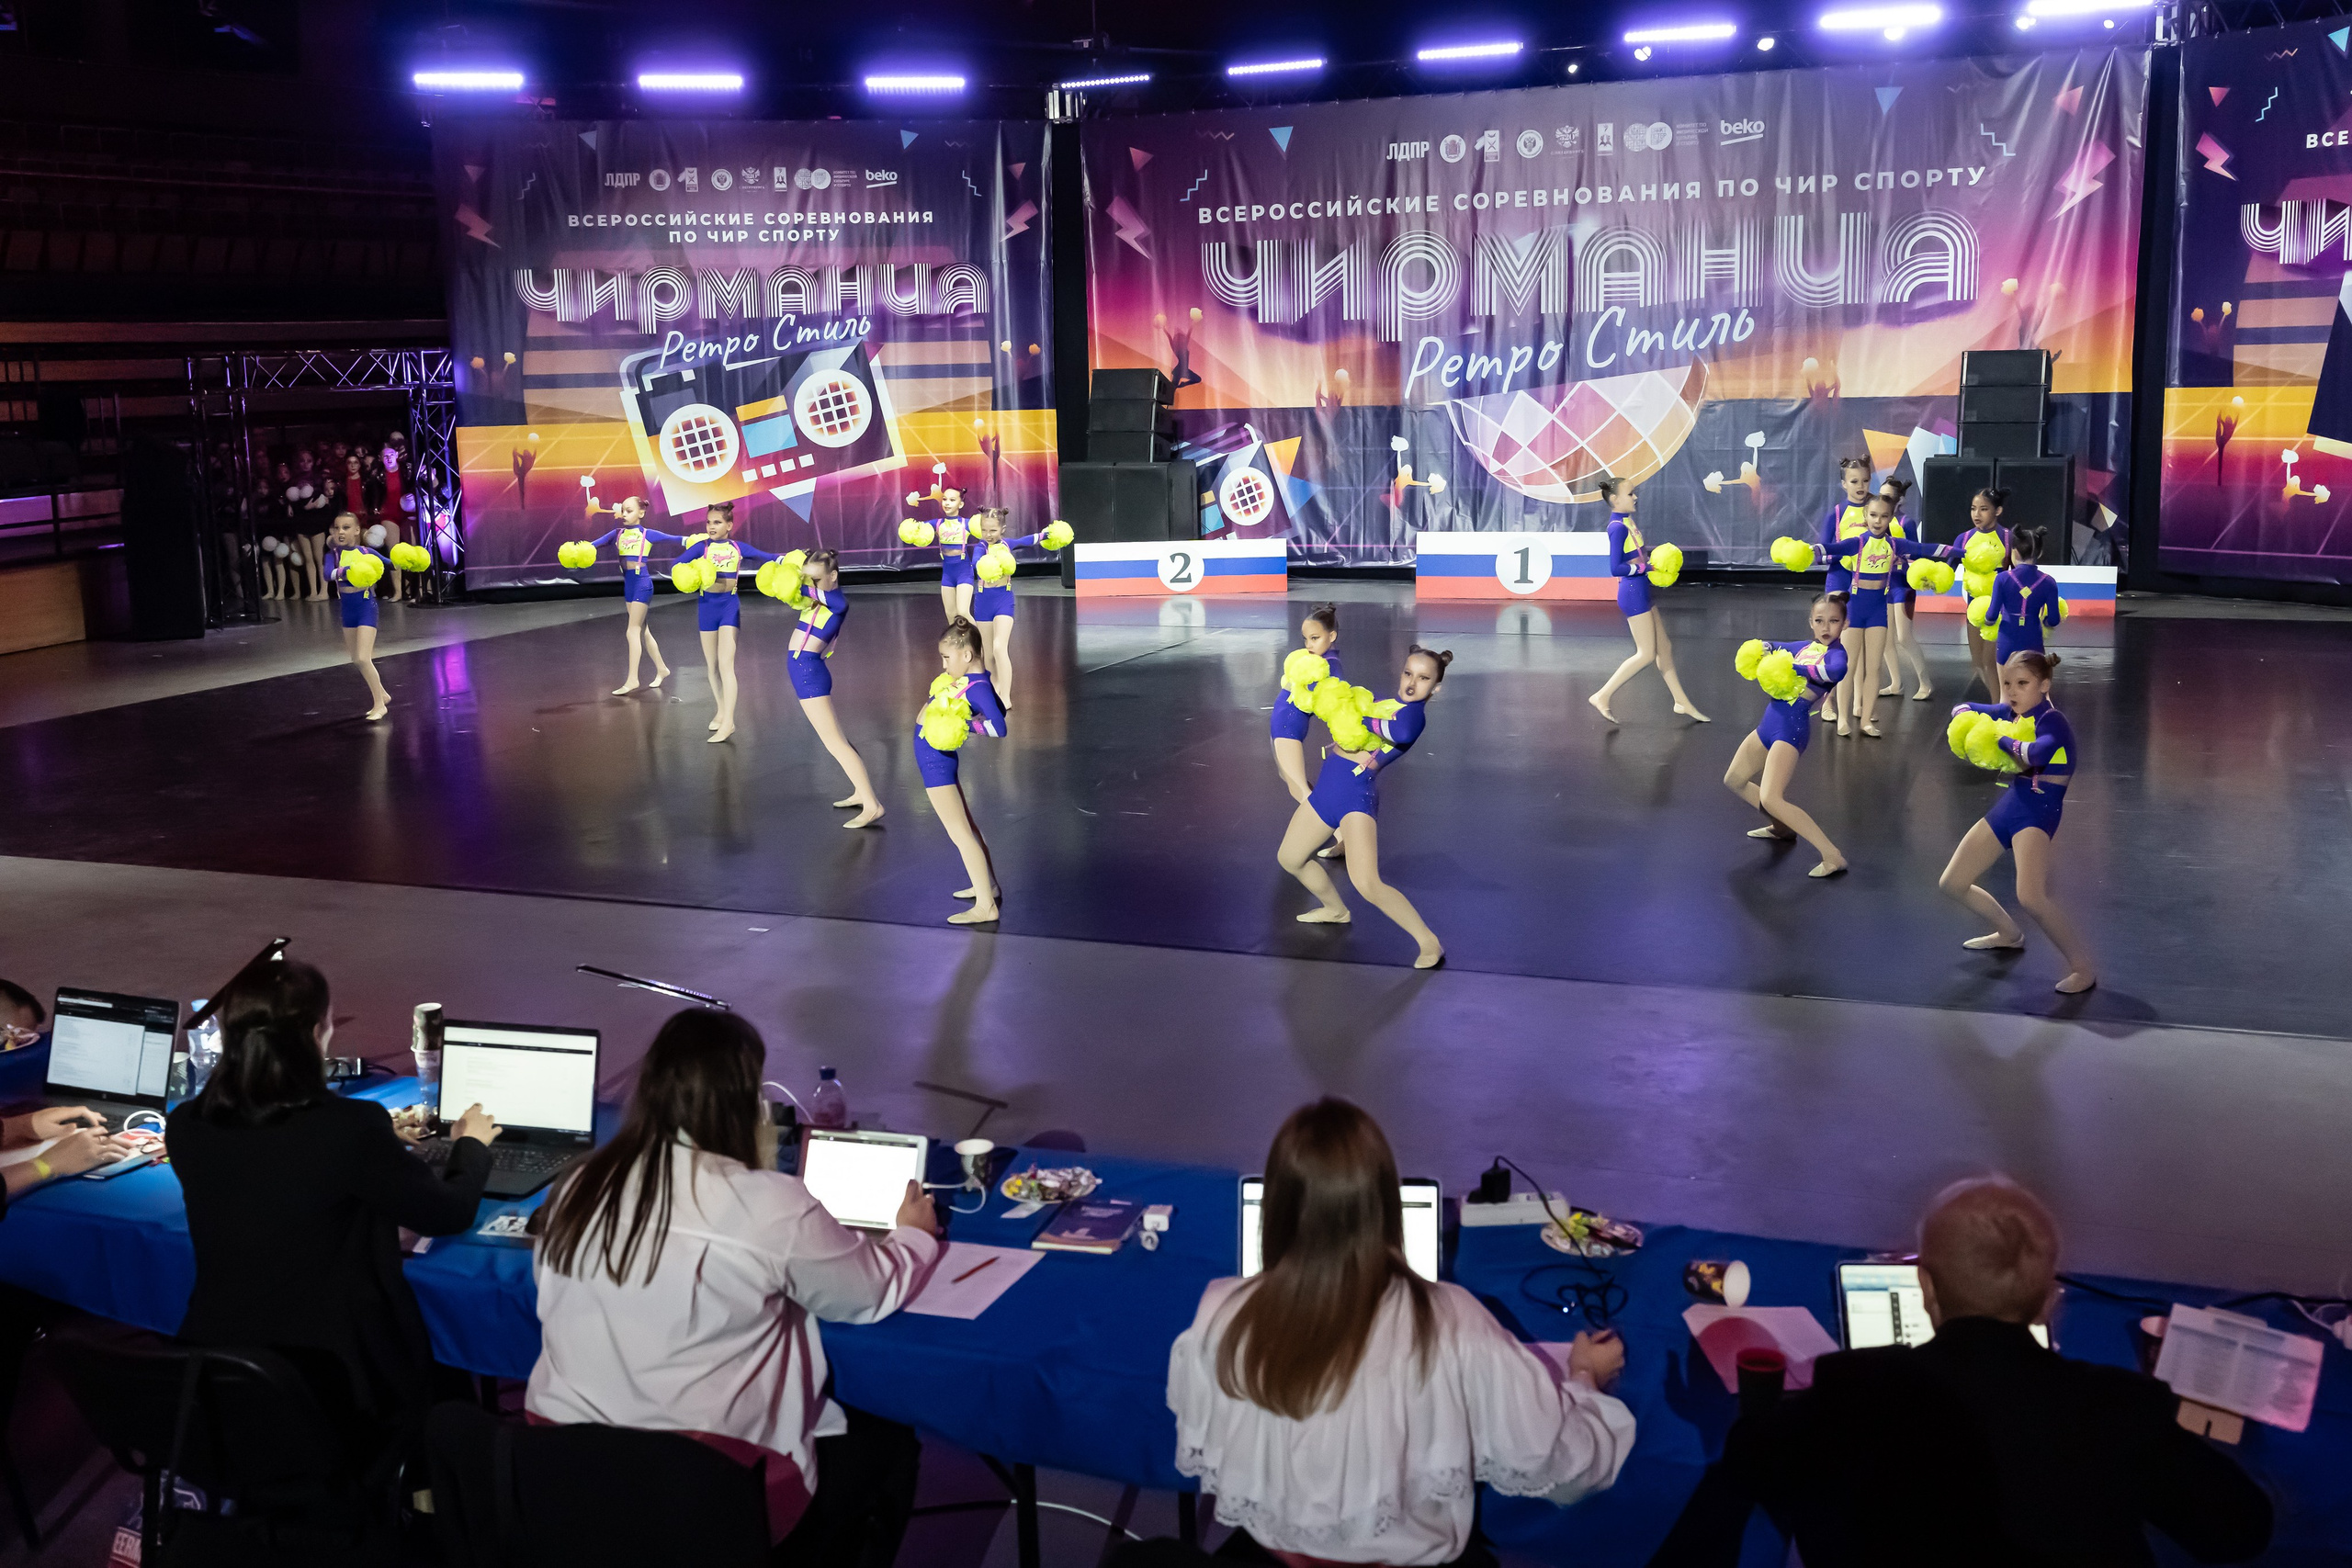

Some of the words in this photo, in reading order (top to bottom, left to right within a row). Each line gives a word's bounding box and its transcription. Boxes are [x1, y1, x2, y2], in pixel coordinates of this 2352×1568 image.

[1720, 118, 1765, 135] beko
[1386, 141, 1430, 162] ЛДПР
[605, 172, 641, 188] ЛДПР
[865, 169, 899, 181] beko
[1198, 193, 1439, 225] ВСЕРОССИЙСКИЕ
[1454, 182, 1701, 210] СОРЕВНОВАНИЯ
[1718, 178, 1758, 197] ПО
[1776, 173, 1838, 194] ЧИР
[1855, 167, 1986, 190] СПОРТУ
[568, 210, 754, 228] ВСЕРОССИЙСКИЕ
[764, 209, 934, 226] СОРЕВНОВАНИЯ
[669, 231, 697, 243] ПО
[707, 230, 750, 243] ЧИР
[758, 228, 841, 243] СПОРТУ
[660, 330, 760, 369] Ретро
[773, 313, 871, 351] Стиль
[1404, 336, 1564, 400] Ретро
[1586, 305, 1755, 368] Стиль
[1170, 552, 1192, 583] 2
[1514, 547, 1533, 584] 1
